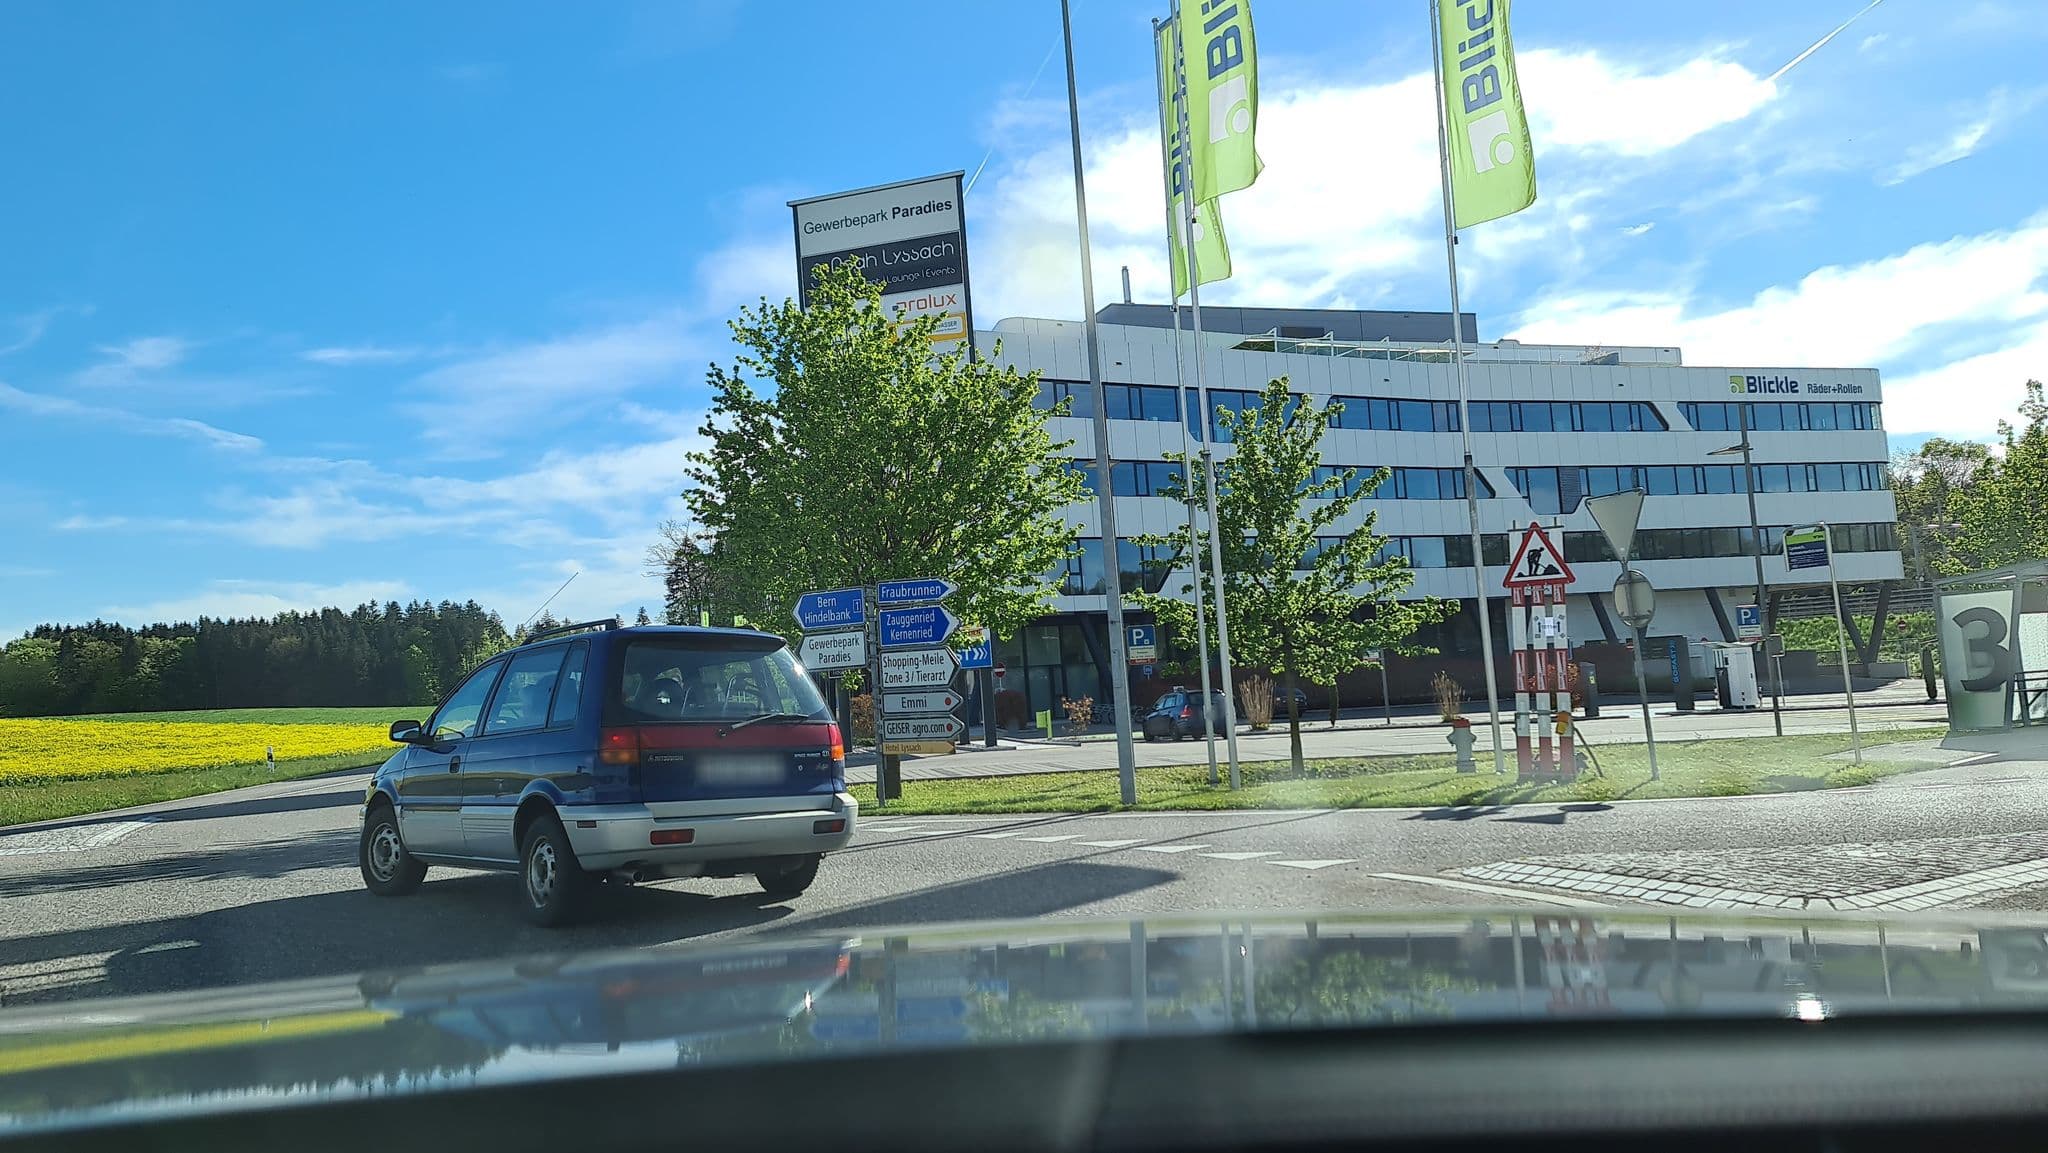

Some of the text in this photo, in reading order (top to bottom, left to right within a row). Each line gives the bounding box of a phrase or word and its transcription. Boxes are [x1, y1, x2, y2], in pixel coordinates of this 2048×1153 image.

[1457, 0, 1502, 114] Blic
[804, 200, 952, 234] Gewerbepark Paradies
[883, 241, 954, 265] Lyssach
[887, 273, 920, 284] Lounge
[925, 266, 956, 277] Events
[1746, 376, 1863, 394] Blickle Räder+Rollen
[881, 584, 941, 598] Fraubrunnen
[817, 597, 837, 608] Bern
[804, 608, 851, 624] Hindelbank
[886, 609, 935, 628] Zauggenried
[1740, 608, 1751, 624] P
[890, 625, 933, 641] Kernenried
[1132, 628, 1145, 645] P
[808, 634, 860, 650] Gewerbepark
[1952, 606, 2010, 692] 3
[818, 651, 851, 664] Paradies
[882, 652, 945, 670] Shopping-Meile
[884, 672, 903, 684] Zone
[905, 671, 910, 681] 3
[916, 671, 946, 682] Tierarzt
[901, 695, 928, 709] Emmi
[886, 722, 946, 737] GEISER agro.com
[885, 743, 900, 752] Hotel
